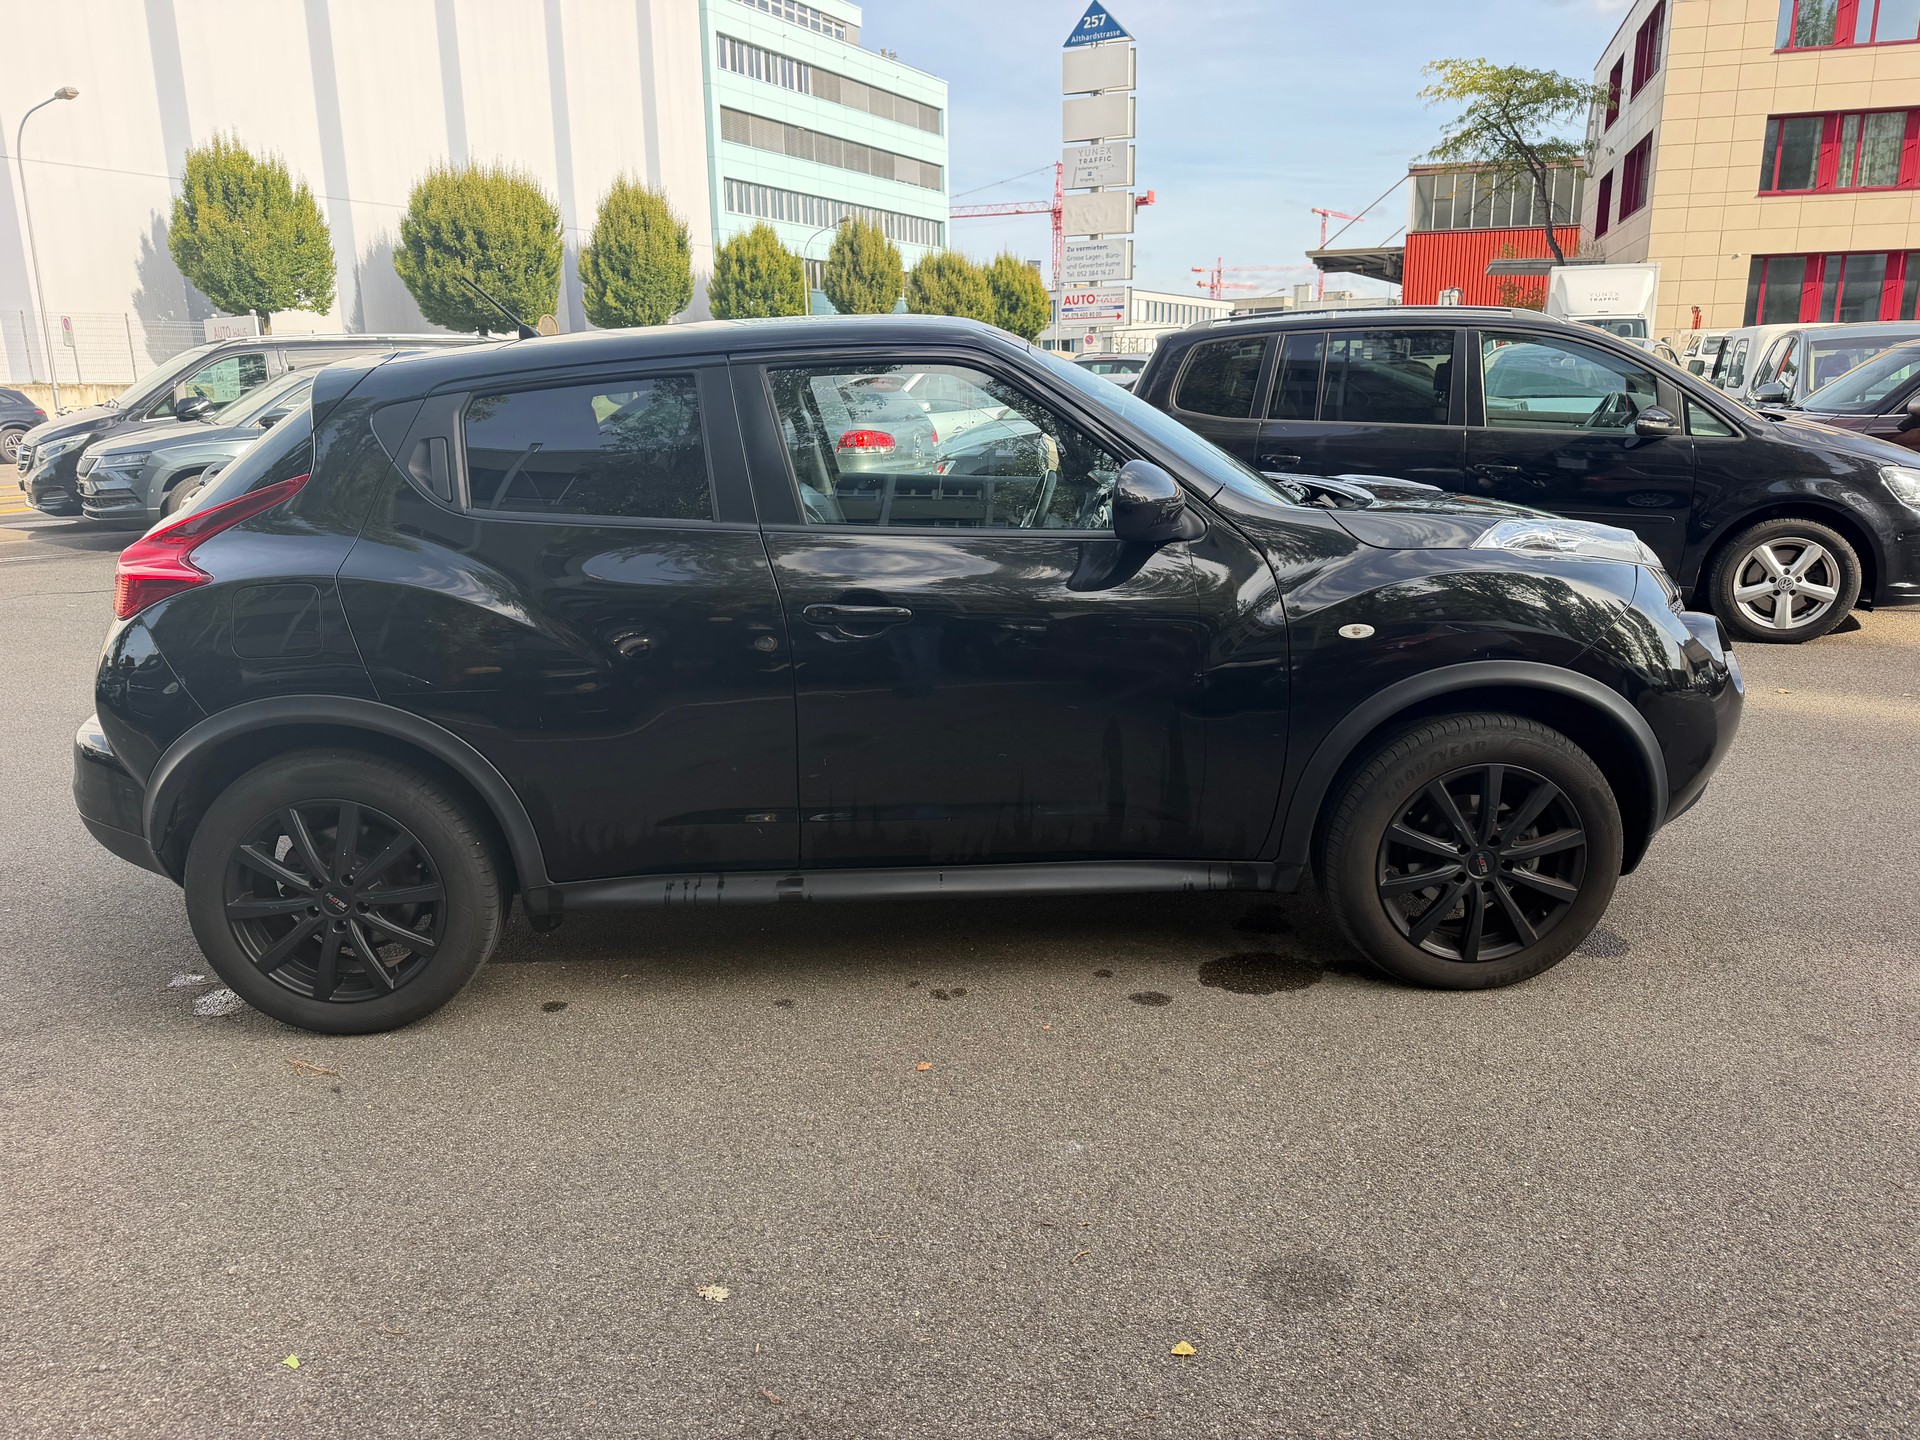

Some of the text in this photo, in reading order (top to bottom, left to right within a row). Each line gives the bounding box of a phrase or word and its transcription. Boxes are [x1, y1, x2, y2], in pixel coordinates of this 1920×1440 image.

[1083, 13, 1107, 29] 257
[1071, 30, 1121, 43] Althardstrasse
[1078, 146, 1112, 157] YUNEX
[1078, 155, 1112, 164] TRAFFIC
[1075, 244, 1109, 252] vermieten:
[1077, 261, 1121, 269] Gewerberäume
[1063, 294, 1096, 306] AUTO
[1096, 296, 1125, 304] HAUS
[213, 326, 248, 339] AUTO HAUS
